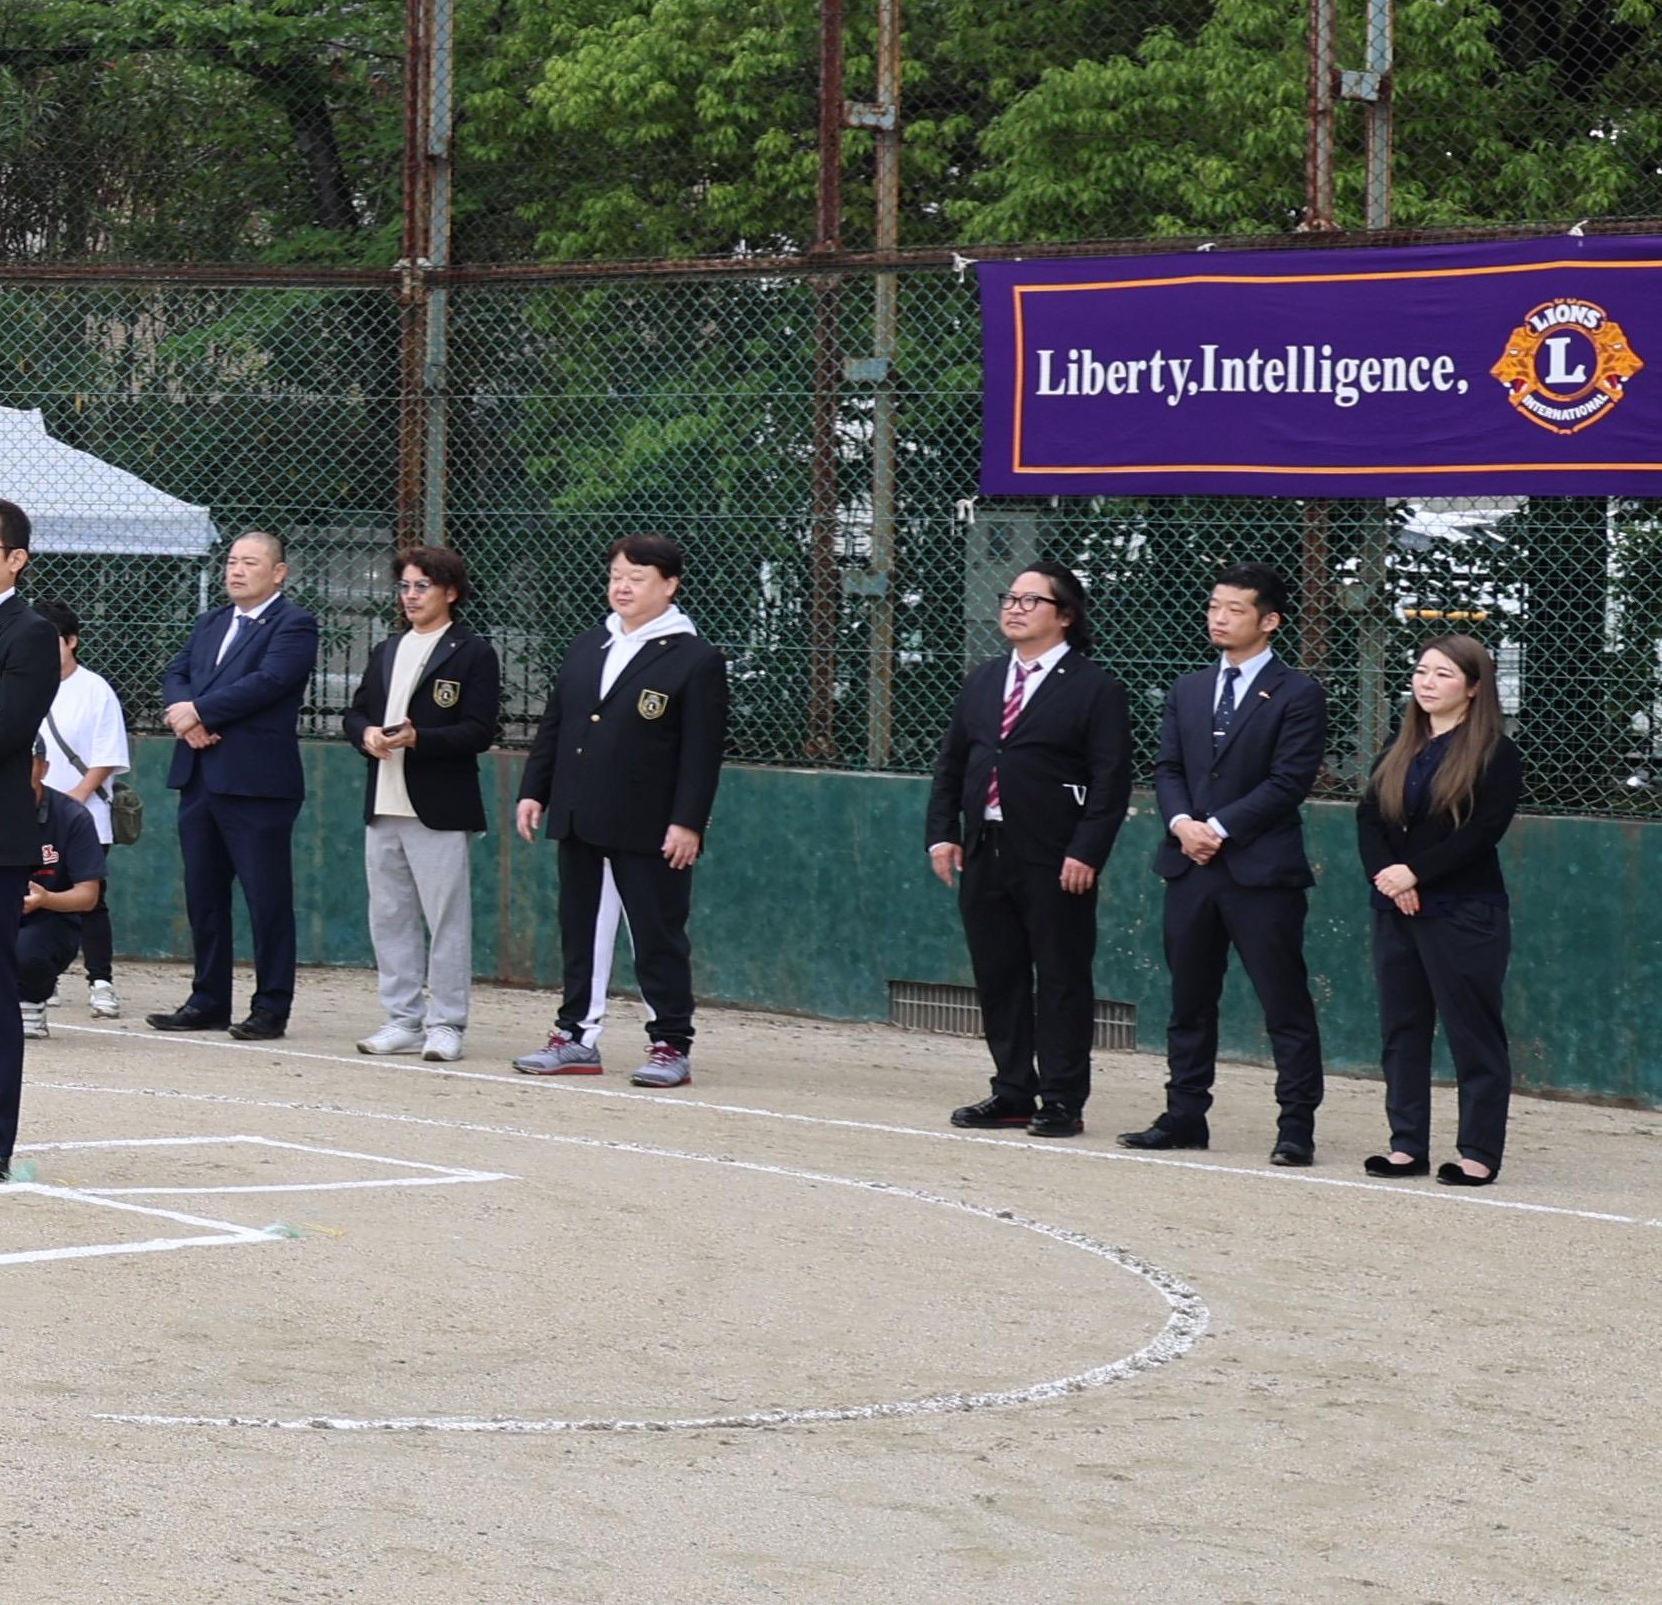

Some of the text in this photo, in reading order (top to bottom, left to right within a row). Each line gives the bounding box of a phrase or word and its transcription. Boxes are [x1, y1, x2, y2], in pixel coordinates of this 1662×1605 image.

[1530, 304, 1602, 332] LIONS
[1544, 337, 1588, 384] L
[1521, 393, 1610, 421] INTERNATIONAL
